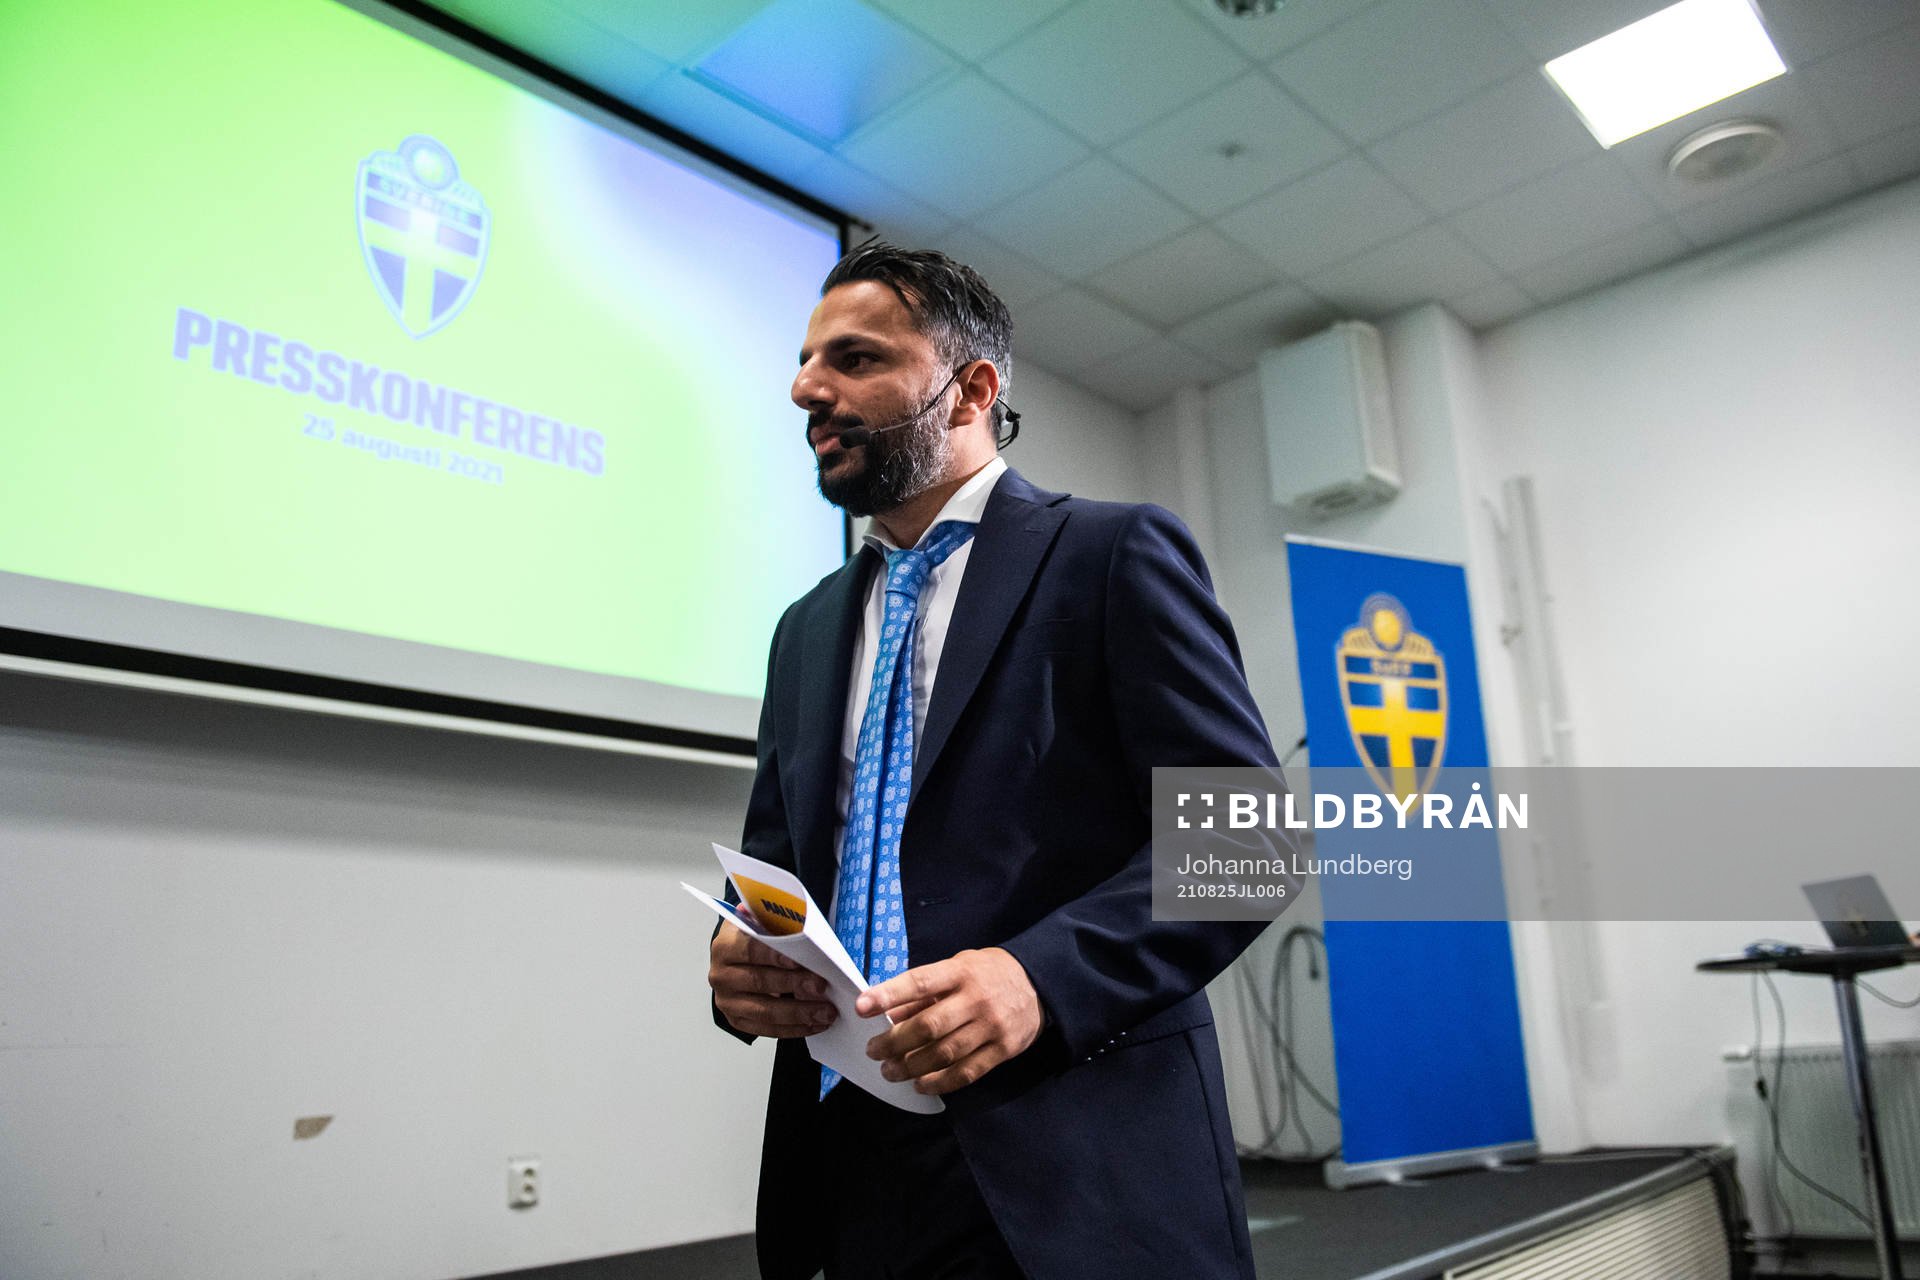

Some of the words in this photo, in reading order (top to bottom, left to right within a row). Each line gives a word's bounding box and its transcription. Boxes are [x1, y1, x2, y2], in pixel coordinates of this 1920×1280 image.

[173, 305, 605, 475] PRESSKONFERENS
[303, 413, 335, 440] 25
[342, 428, 441, 467] augusti
[448, 451, 504, 484] 2021
